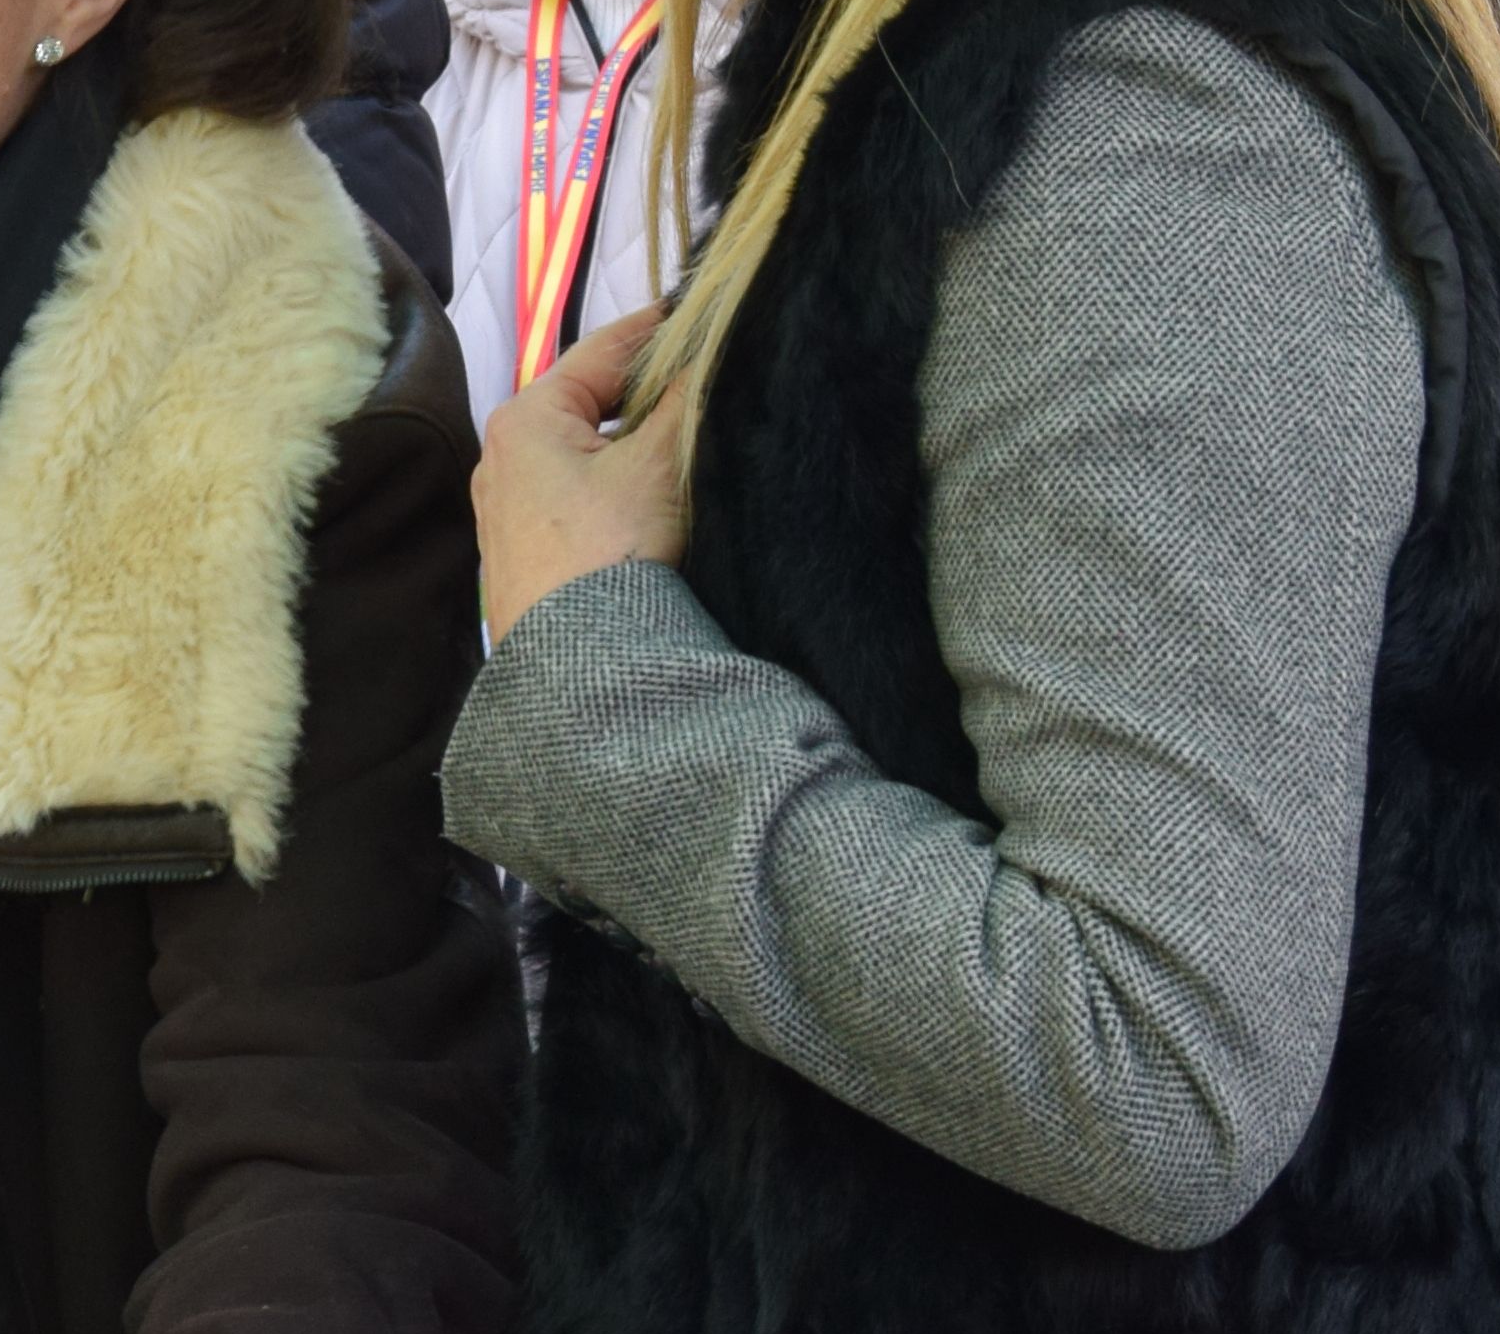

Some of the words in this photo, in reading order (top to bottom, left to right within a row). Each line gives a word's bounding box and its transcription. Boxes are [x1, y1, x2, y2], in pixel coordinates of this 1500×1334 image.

[535, 57, 553, 123] ESPAÑA
[531, 128, 549, 194] SIEMPRE
[572, 117, 604, 181] ESPAÑA
